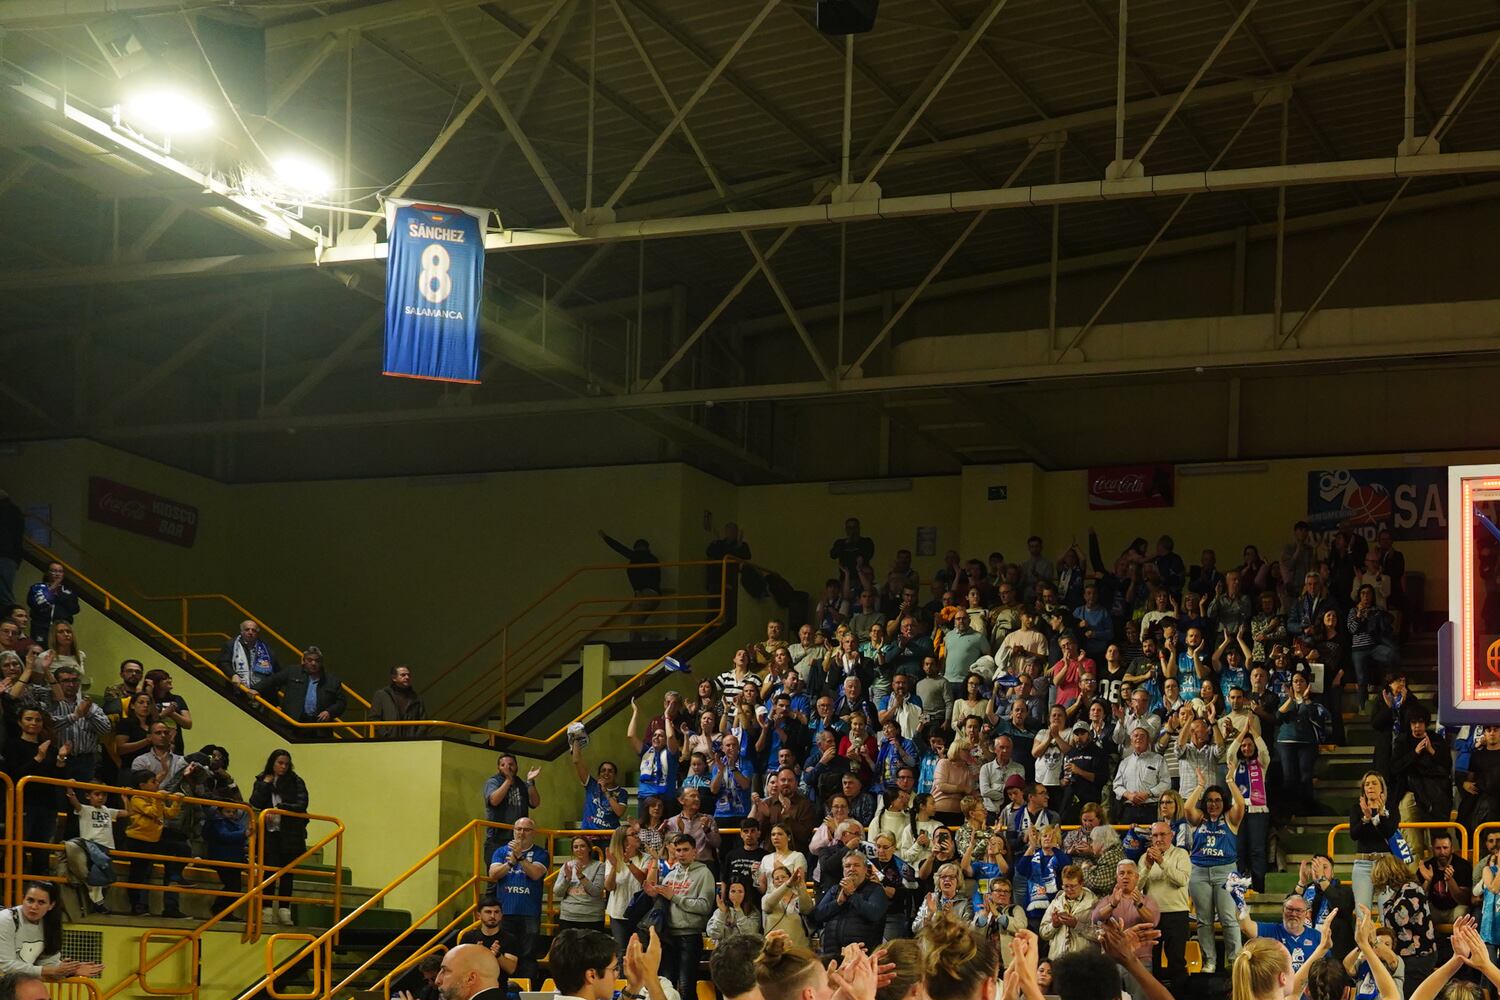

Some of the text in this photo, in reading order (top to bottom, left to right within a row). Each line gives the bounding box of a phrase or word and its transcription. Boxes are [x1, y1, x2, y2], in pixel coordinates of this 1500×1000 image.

[409, 223, 464, 242] SÁNCHEZ
[419, 244, 451, 303] 8
[405, 306, 463, 320] SALAMANCA
[159, 520, 184, 538] BAR
[1202, 848, 1224, 857] YRSA
[507, 886, 530, 894] YRSA
